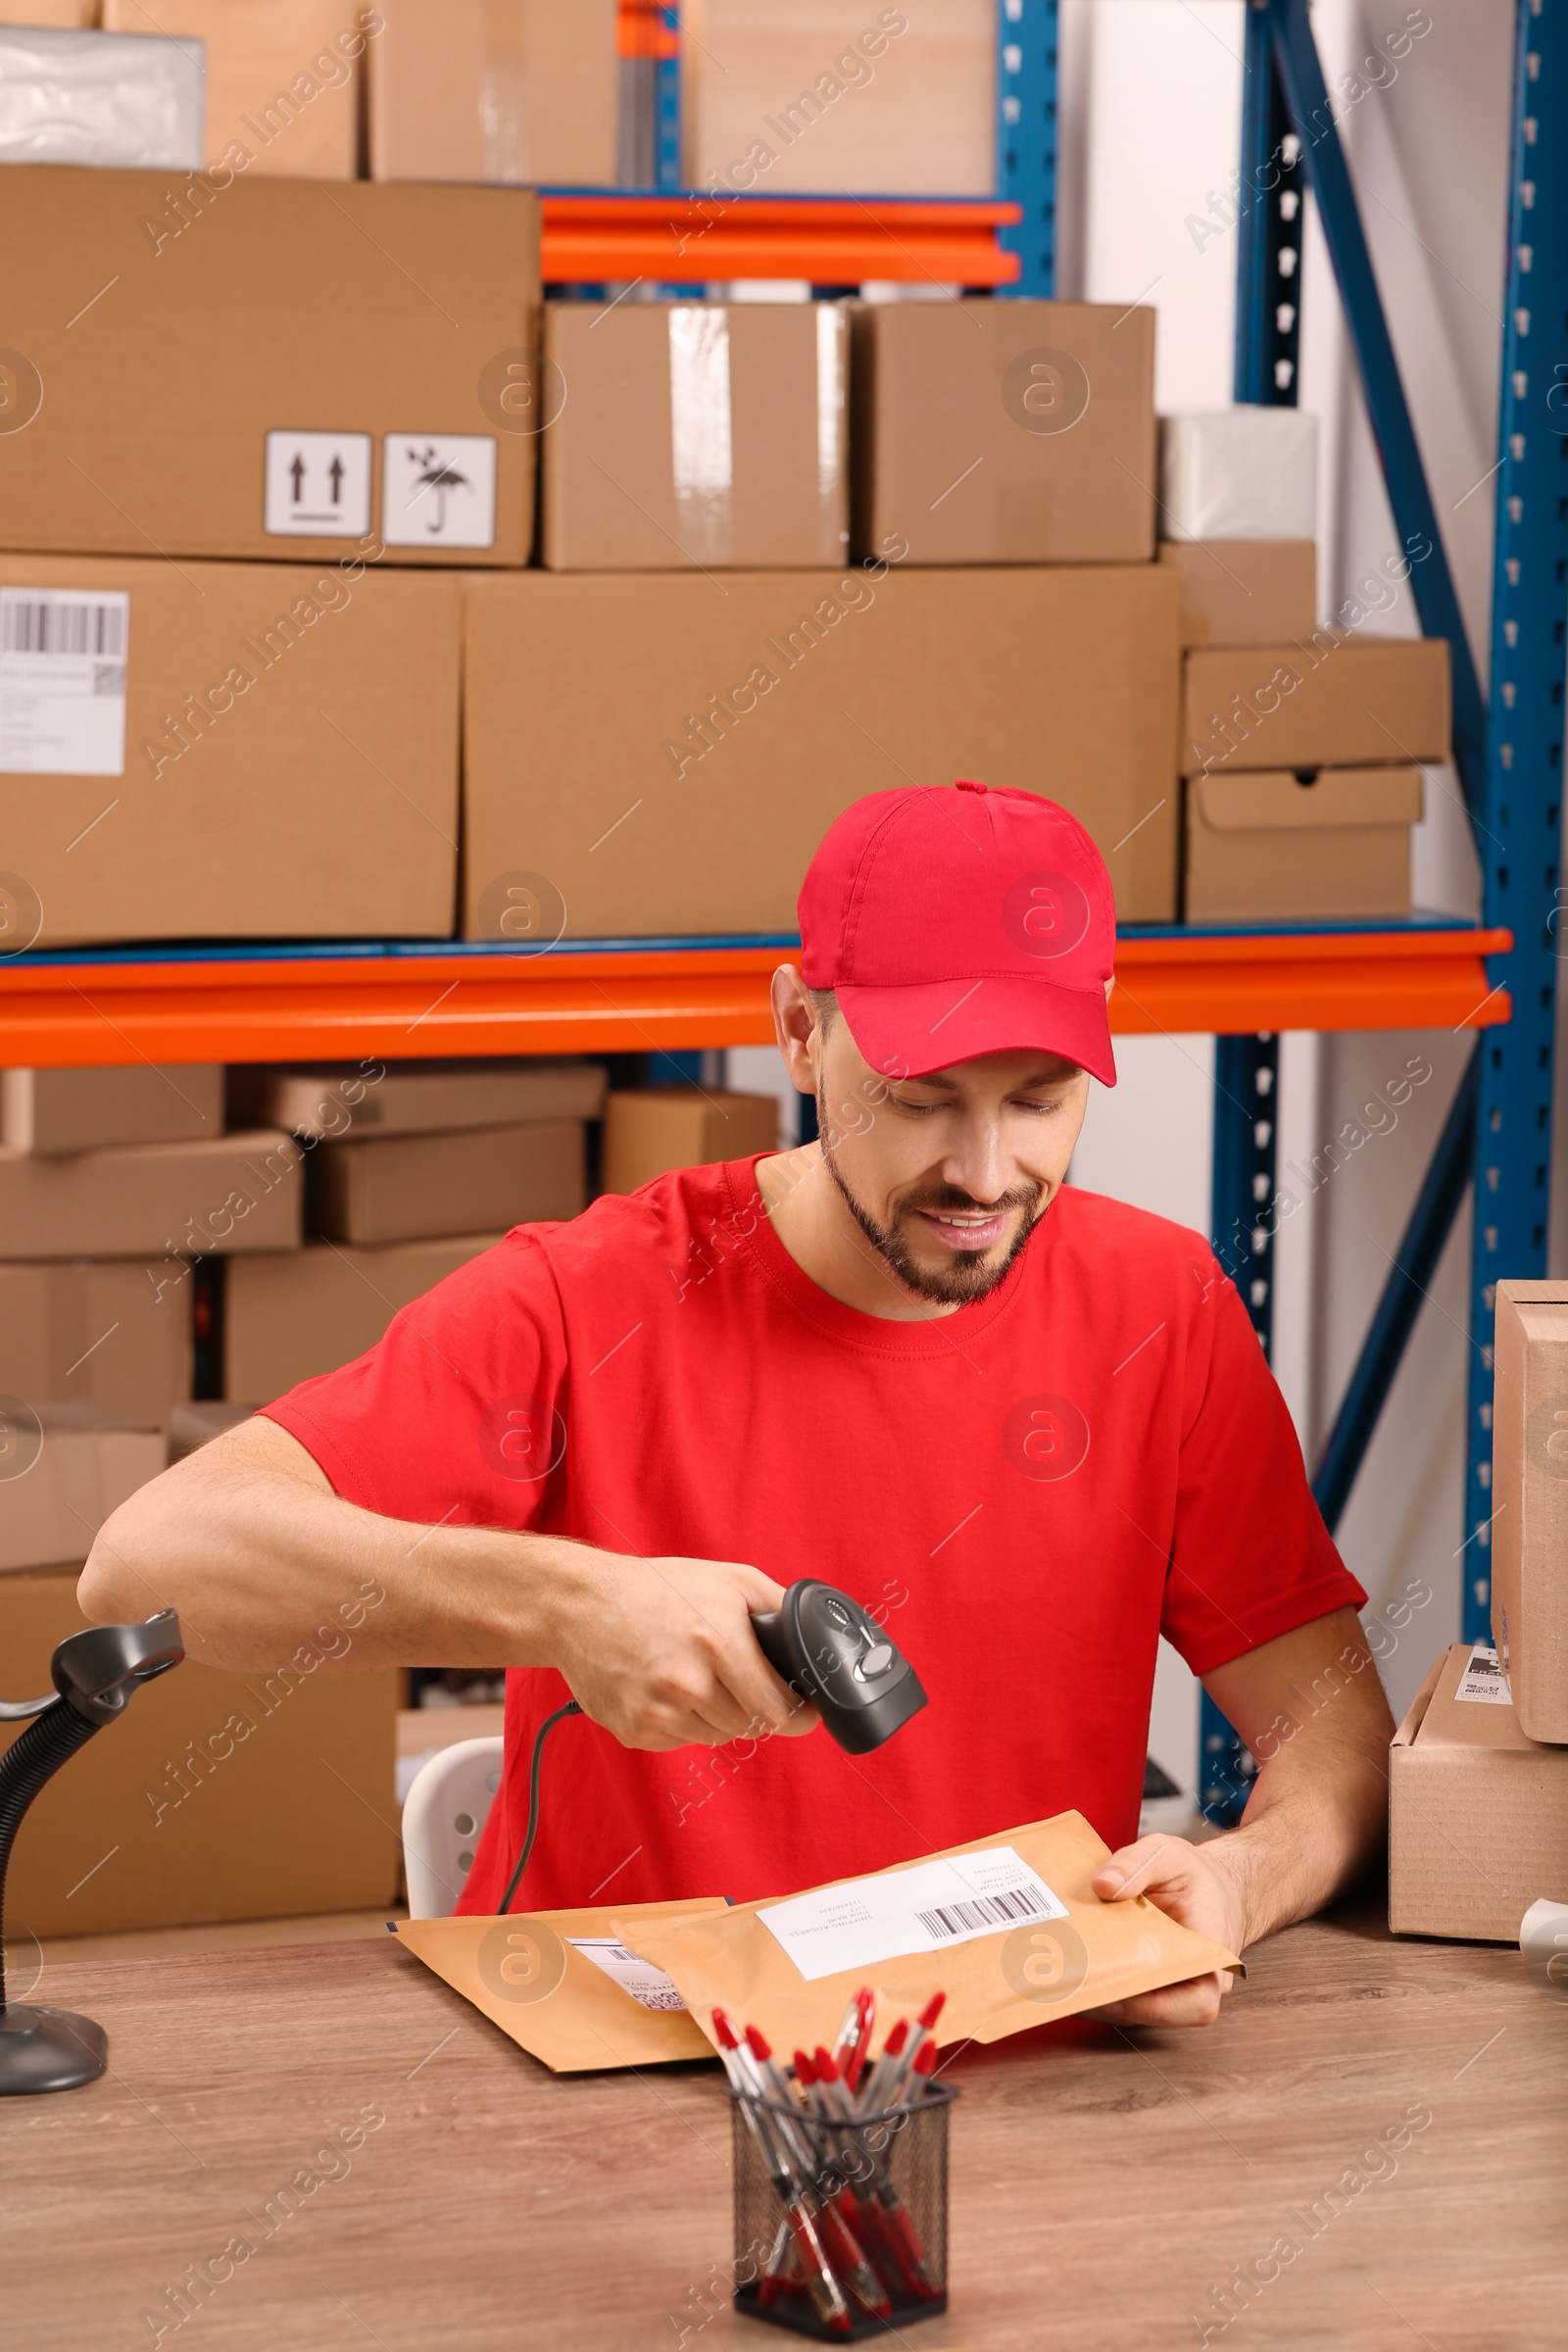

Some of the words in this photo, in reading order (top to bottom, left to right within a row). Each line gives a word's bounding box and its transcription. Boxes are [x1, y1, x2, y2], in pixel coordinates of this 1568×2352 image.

[1007, 1876, 1028, 1886] SENT
[979, 1883, 1004, 1891] FROM
[827, 1915, 848, 1924] NAME
[849, 1910, 869, 1920] YOUR
[831, 1915, 873, 1929] SHIPPING
[789, 1925, 829, 1937] ADDRESS
